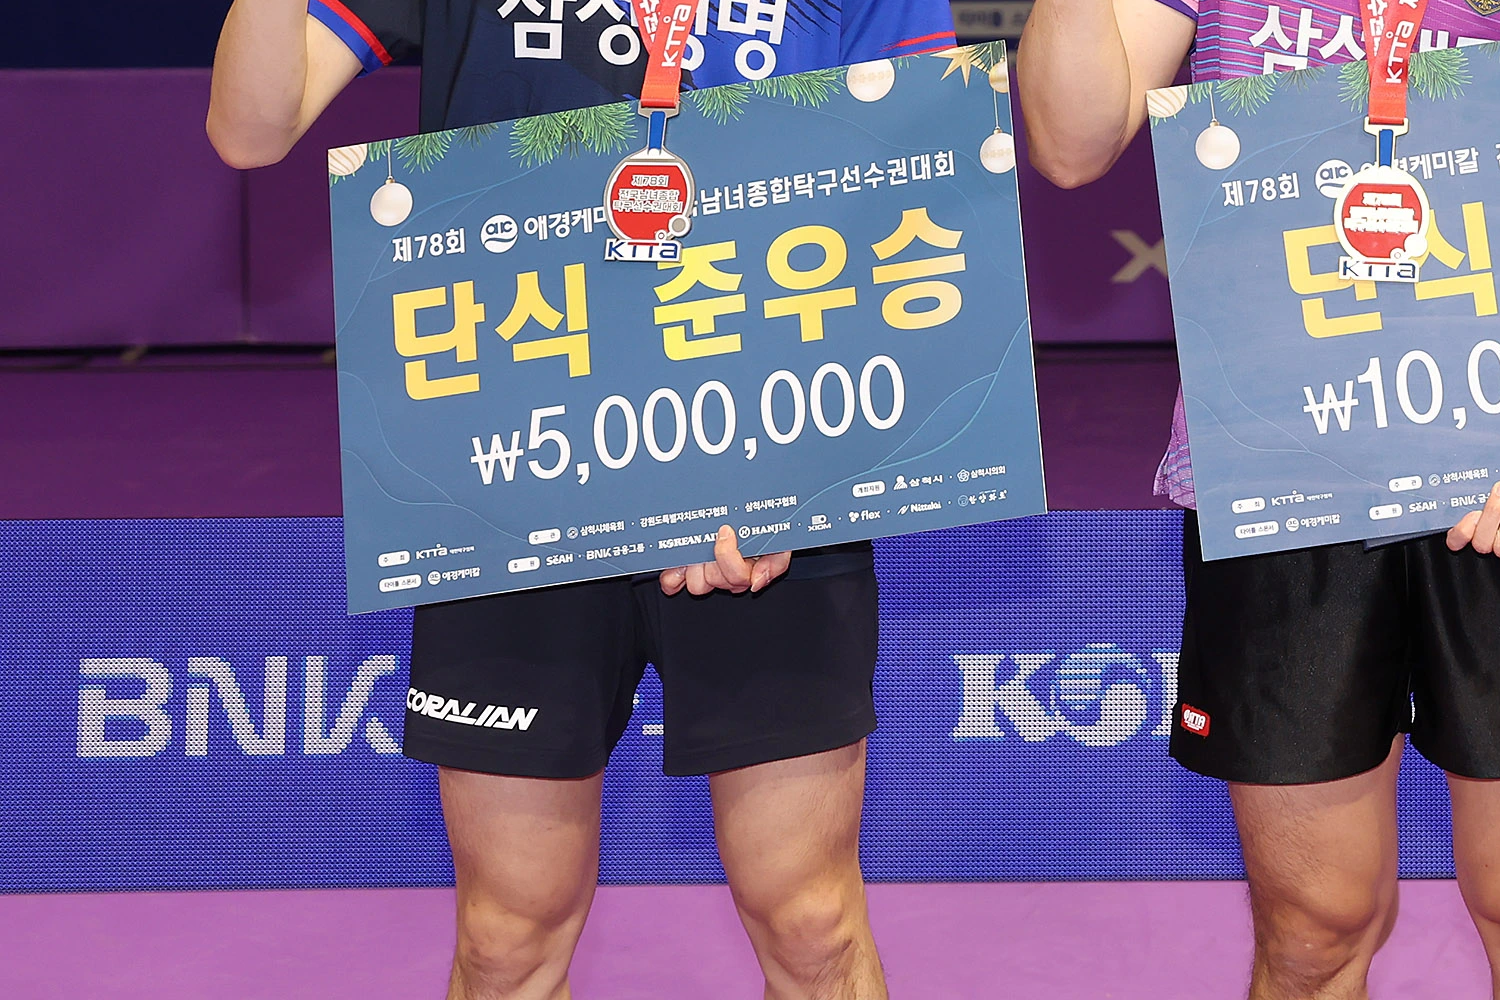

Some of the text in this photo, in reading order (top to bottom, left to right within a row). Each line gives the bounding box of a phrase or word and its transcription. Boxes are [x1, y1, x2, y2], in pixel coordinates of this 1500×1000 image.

[618, 189, 680, 202] 전국남녀종합
[632, 175, 670, 187] 제78회
[1221, 173, 1301, 208] 제78회
[392, 226, 466, 265] 제78회
[690, 149, 957, 219] 남녀종합탁구선수권대회
[613, 200, 684, 213] 탁구선수권대회
[1283, 201, 1498, 338] 단식
[391, 206, 968, 402] 단식 준우승
[470, 355, 905, 486] ₩5,000,000
[1442, 467, 1489, 485] 삼척시체육회
[580, 520, 625, 536] 삼척시체육회
[745, 495, 797, 513] 삼척시탁구협회
[1450, 494, 1477, 508] BNK
[586, 548, 612, 561] BNK
[612, 543, 645, 557] 금융그룹
[658, 534, 702, 550] KOREAN
[751, 521, 791, 536] HANJIN
[808, 522, 832, 531] XIOM
[860, 509, 881, 522] flex
[1300, 514, 1341, 528] 애경케미칼
[442, 567, 481, 581] 애경케미칼
[77, 654, 403, 758] BNK
[407, 687, 538, 731] CORALIAN
